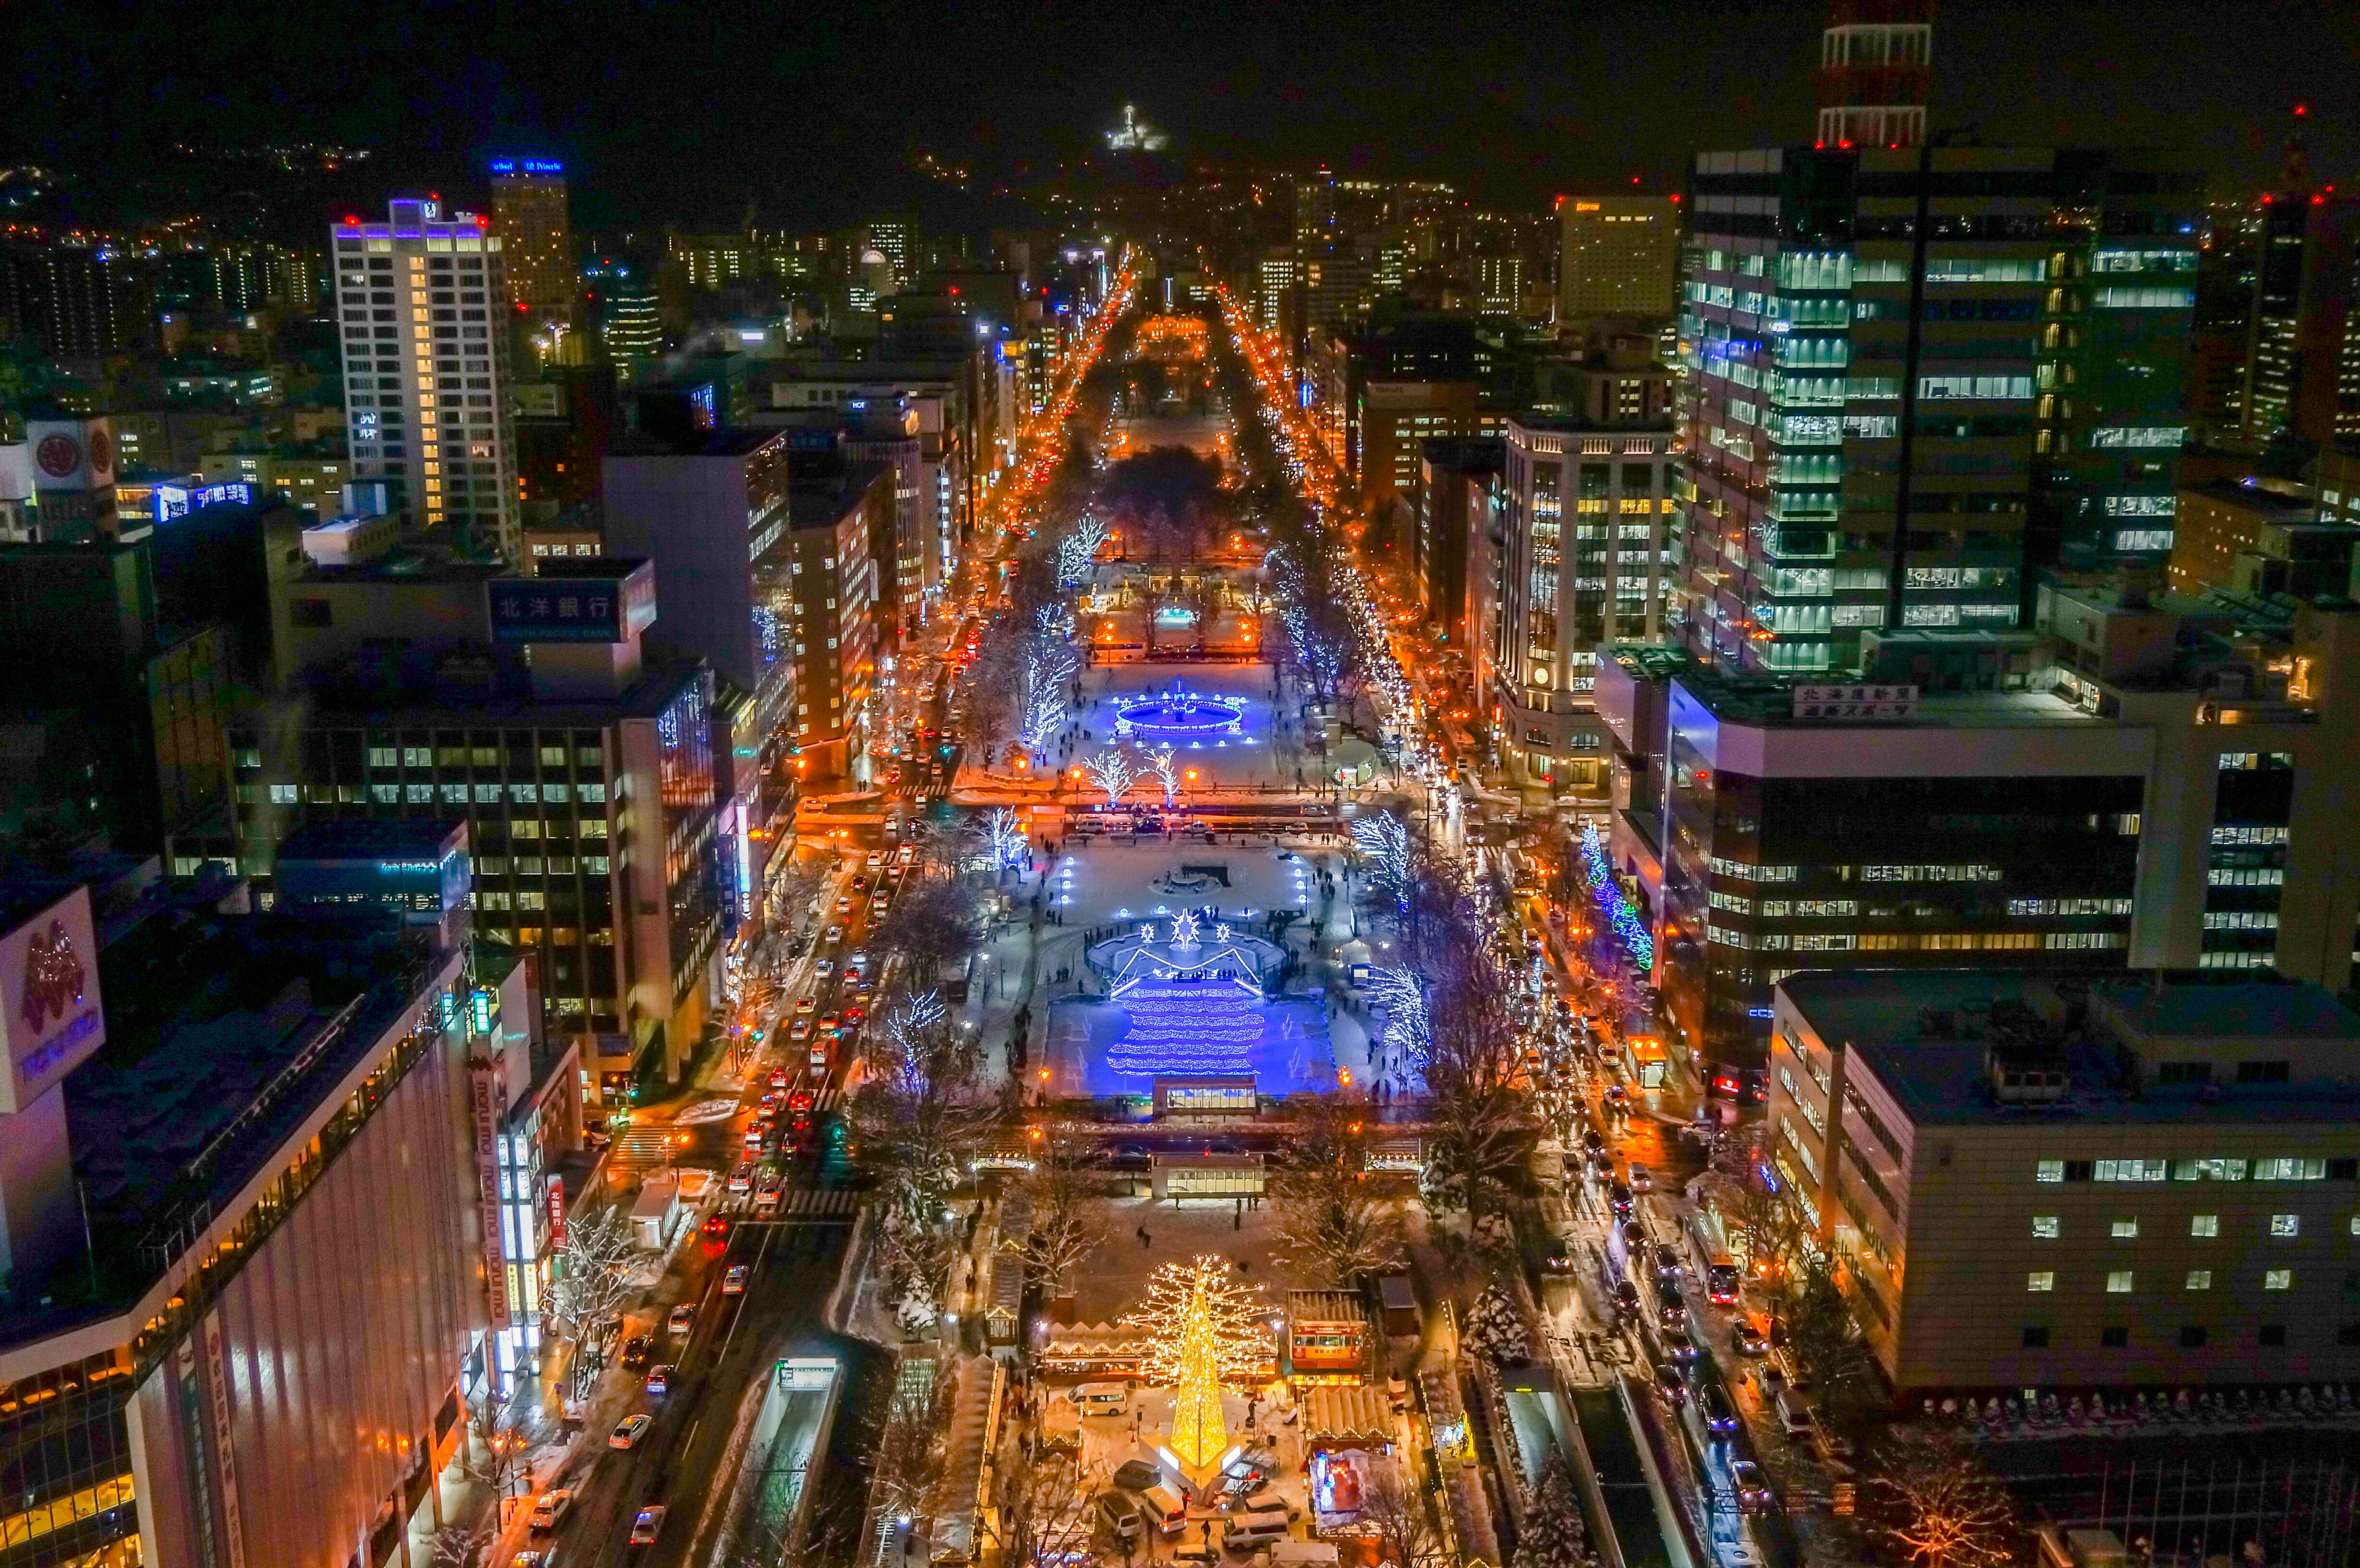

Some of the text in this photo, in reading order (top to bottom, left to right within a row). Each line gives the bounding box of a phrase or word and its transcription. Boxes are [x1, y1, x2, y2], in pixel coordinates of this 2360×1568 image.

[500, 597, 610, 618] 北洋銀行
[477, 1082, 492, 1155] marui imai
[483, 1165, 498, 1237] marui imai
[551, 1192, 561, 1226] 北陸銀行
[490, 1248, 504, 1318] marui imai
